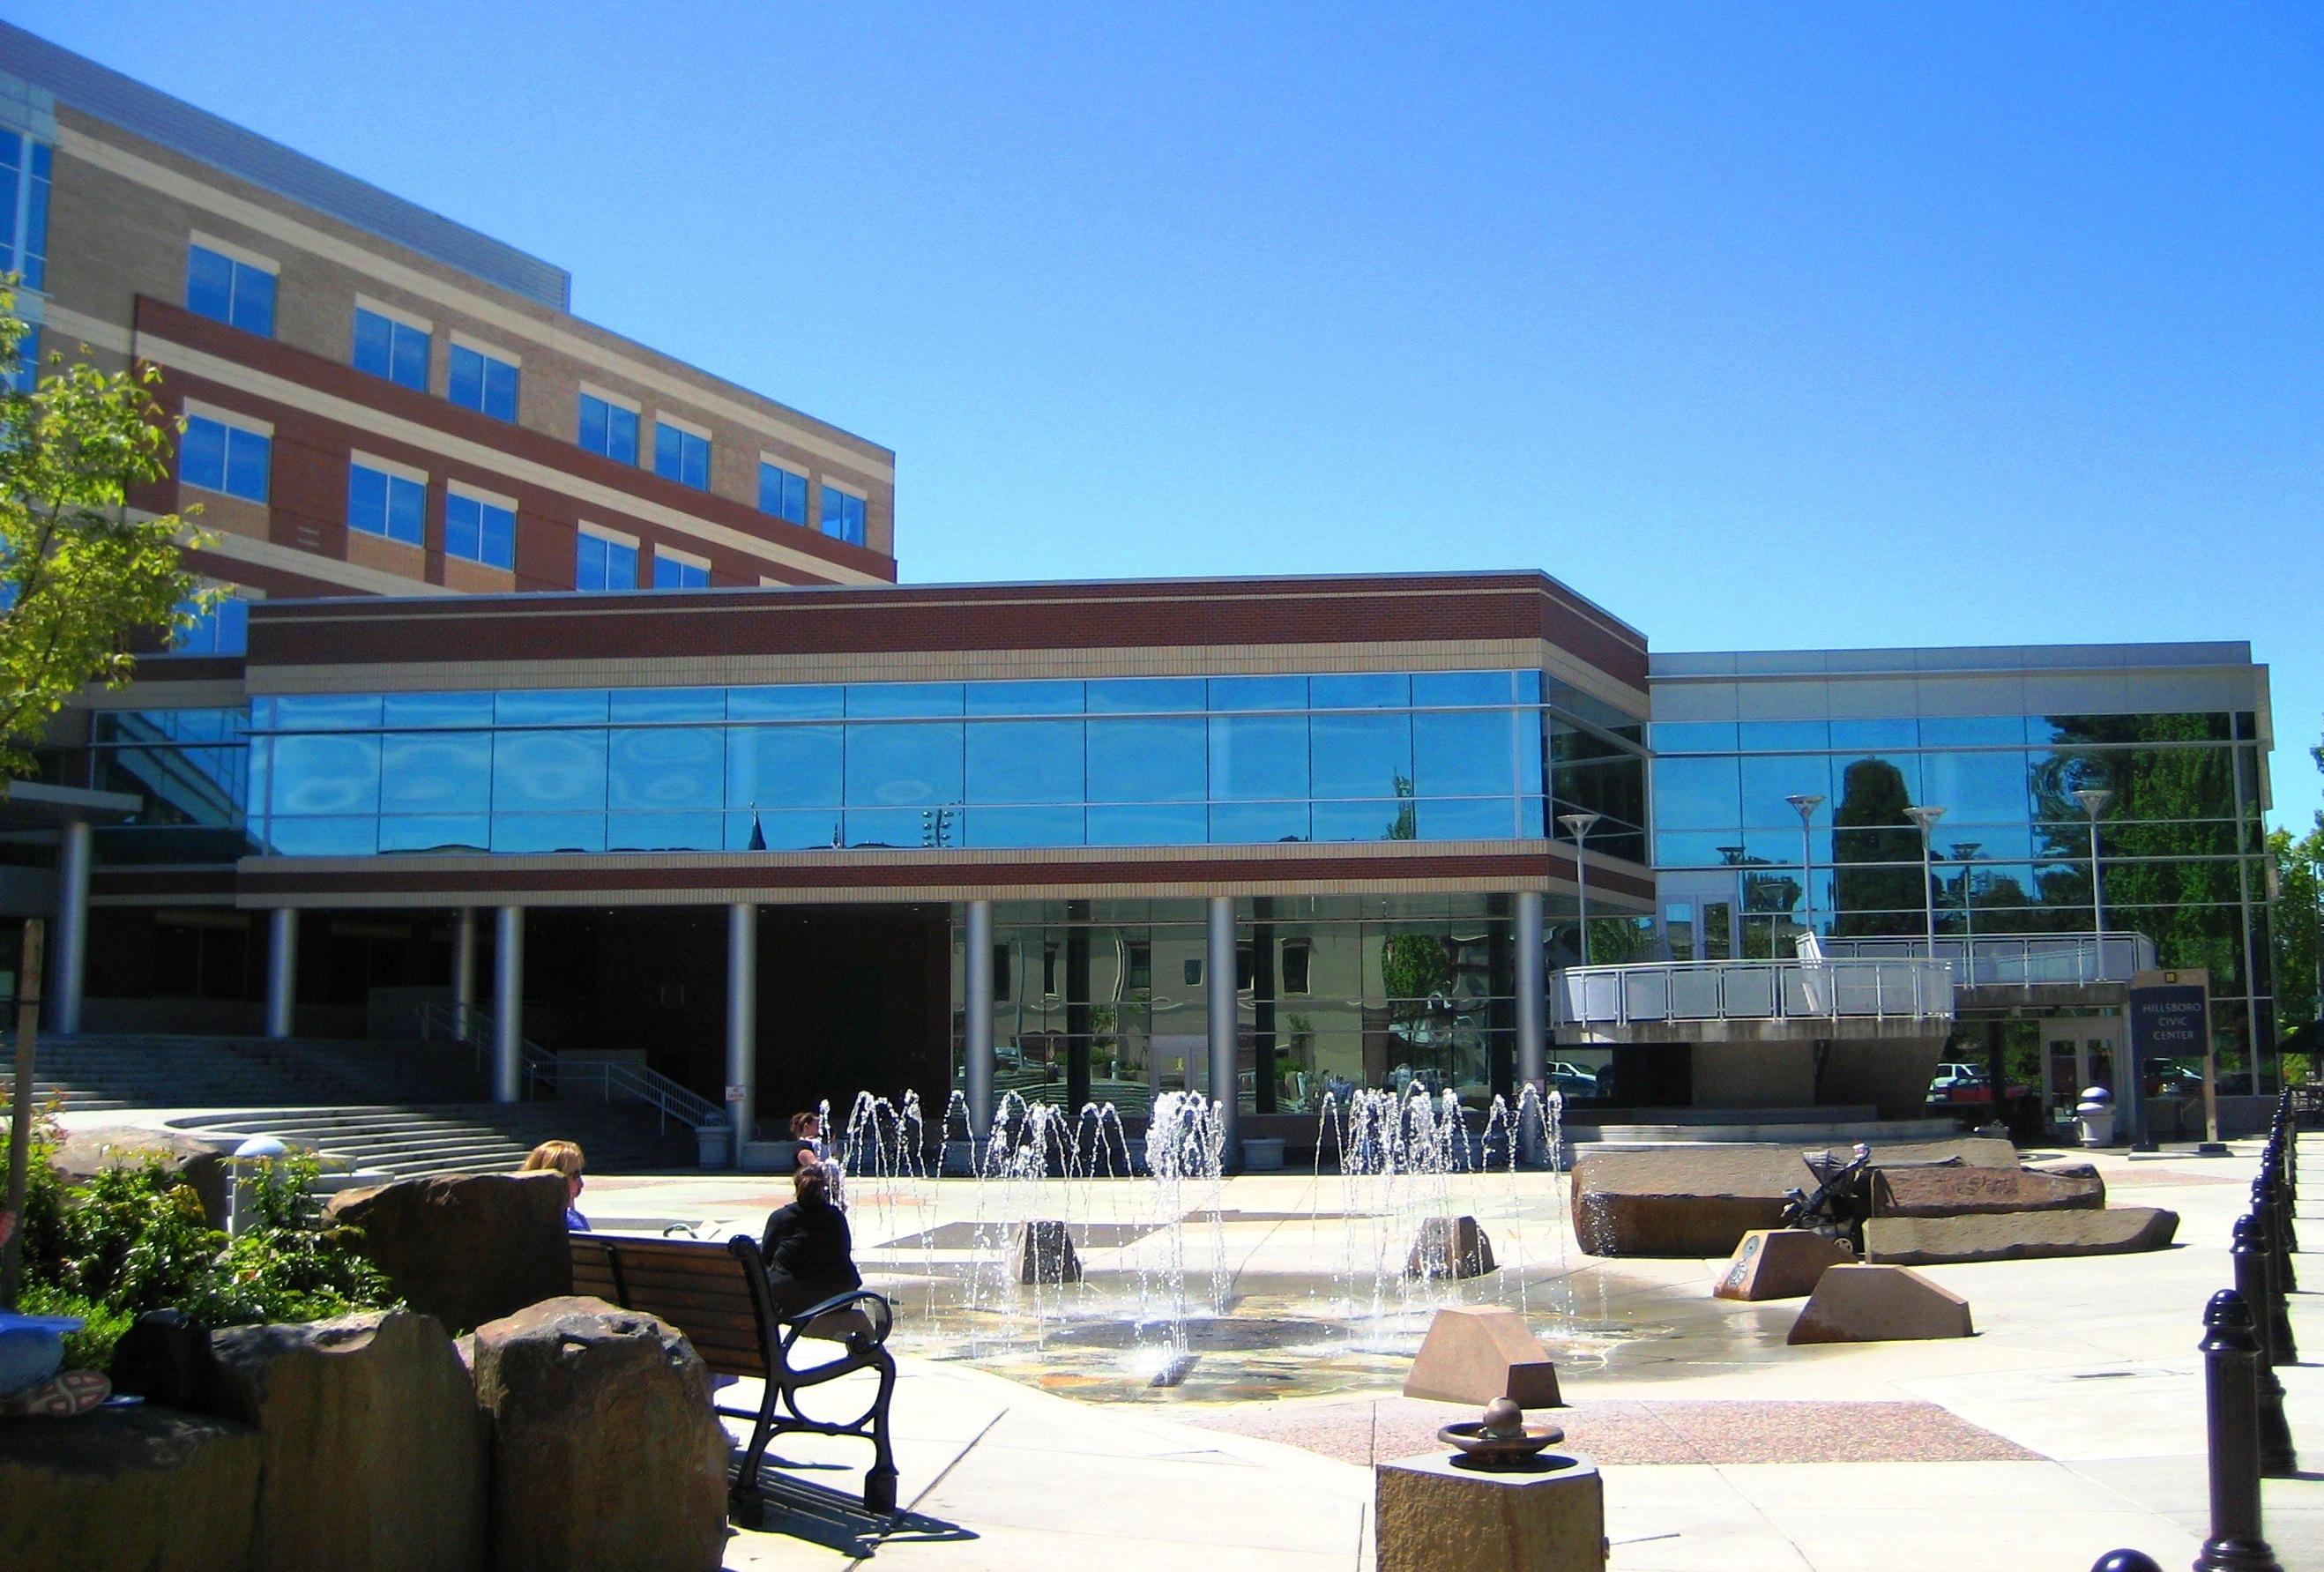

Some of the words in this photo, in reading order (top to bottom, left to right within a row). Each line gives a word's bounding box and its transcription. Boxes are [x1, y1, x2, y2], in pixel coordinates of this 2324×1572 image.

[2142, 1002, 2202, 1013] HILLSBORO
[2158, 1017, 2188, 1026] CIVIC
[2152, 1031, 2194, 1040] CENTER
